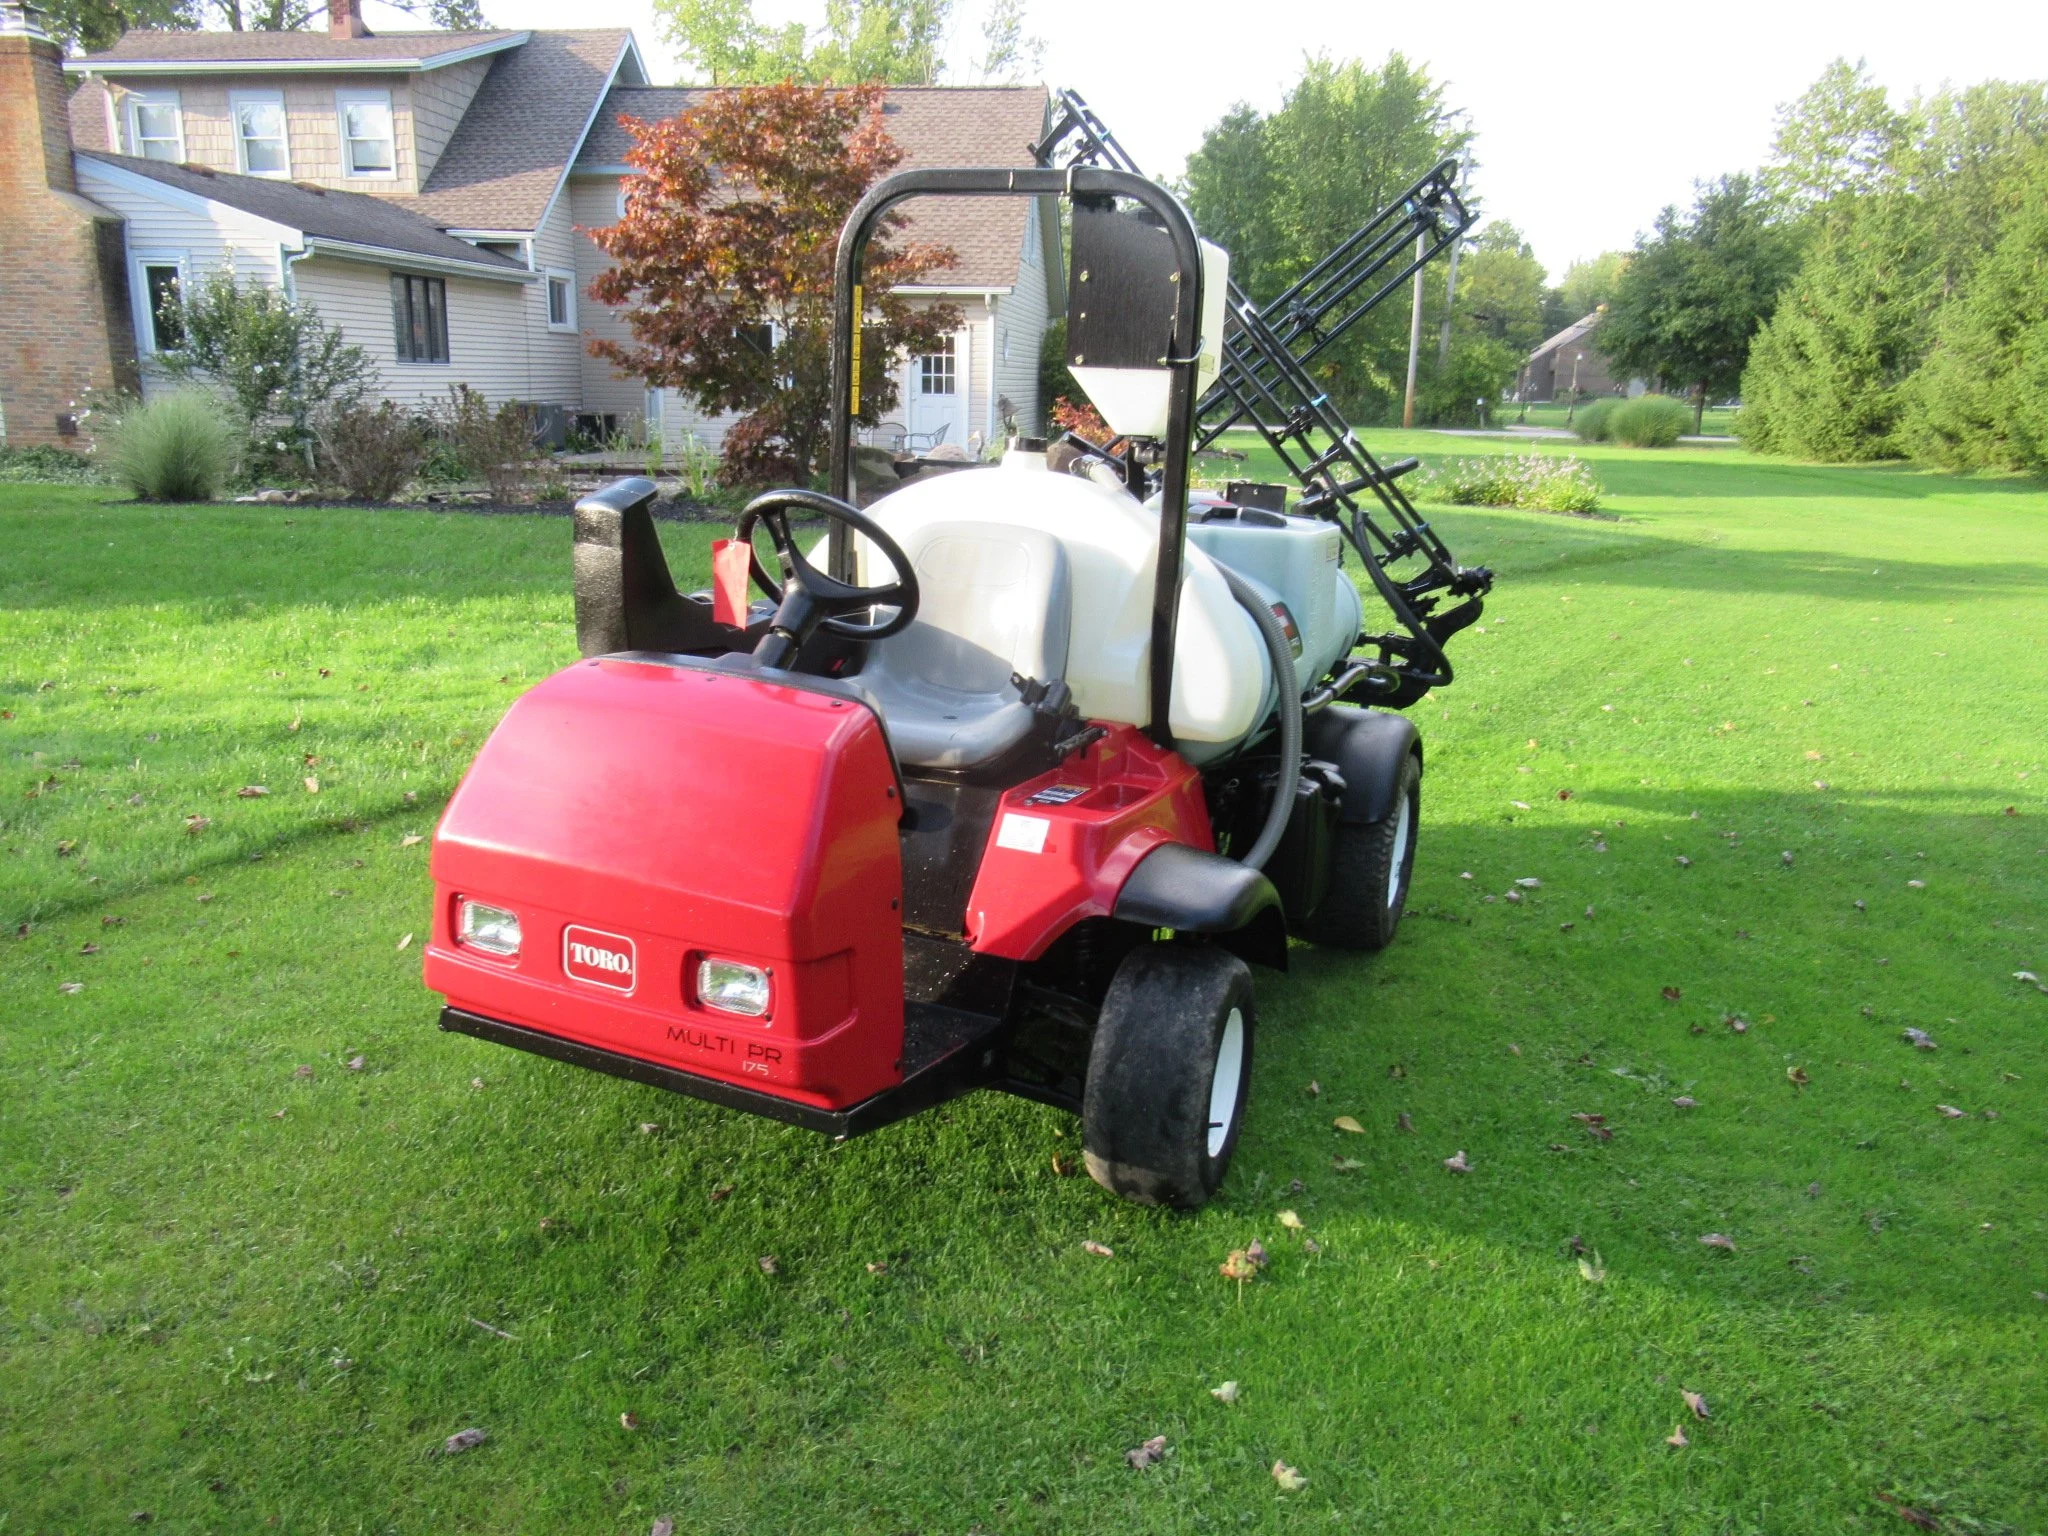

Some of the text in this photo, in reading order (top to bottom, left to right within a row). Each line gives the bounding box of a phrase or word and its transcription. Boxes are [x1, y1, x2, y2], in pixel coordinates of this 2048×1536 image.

[570, 942, 631, 974] TORO
[666, 1026, 735, 1055] MULTI
[742, 1061, 769, 1076] 175
